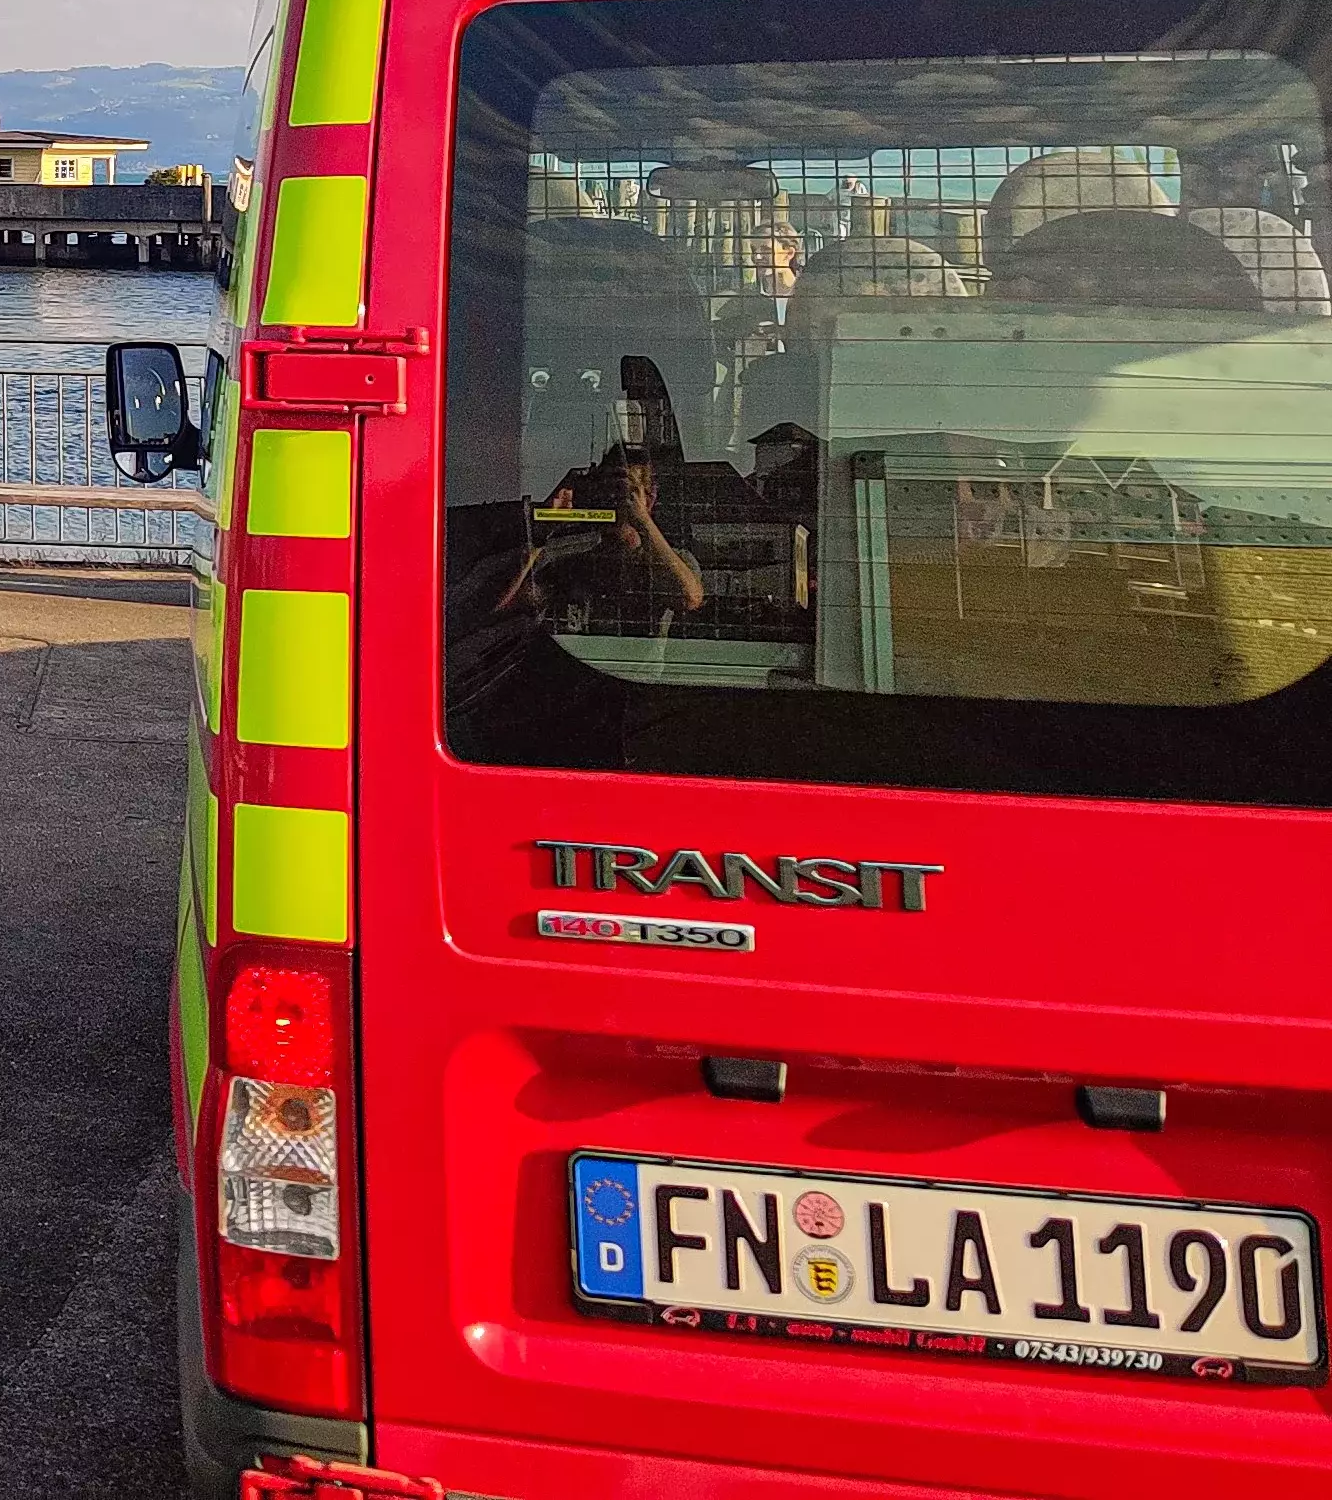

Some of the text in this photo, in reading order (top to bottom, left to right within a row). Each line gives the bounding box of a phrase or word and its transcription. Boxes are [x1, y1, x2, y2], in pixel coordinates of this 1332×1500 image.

[536, 840, 946, 912] TRANSIT
[544, 916, 747, 947] 140 T350
[599, 1241, 624, 1272] D
[656, 1184, 782, 1294] FN
[868, 1202, 1003, 1315] LA
[1030, 1216, 1301, 1339] 1190
[1014, 1340, 1163, 1371] 07543/939730
